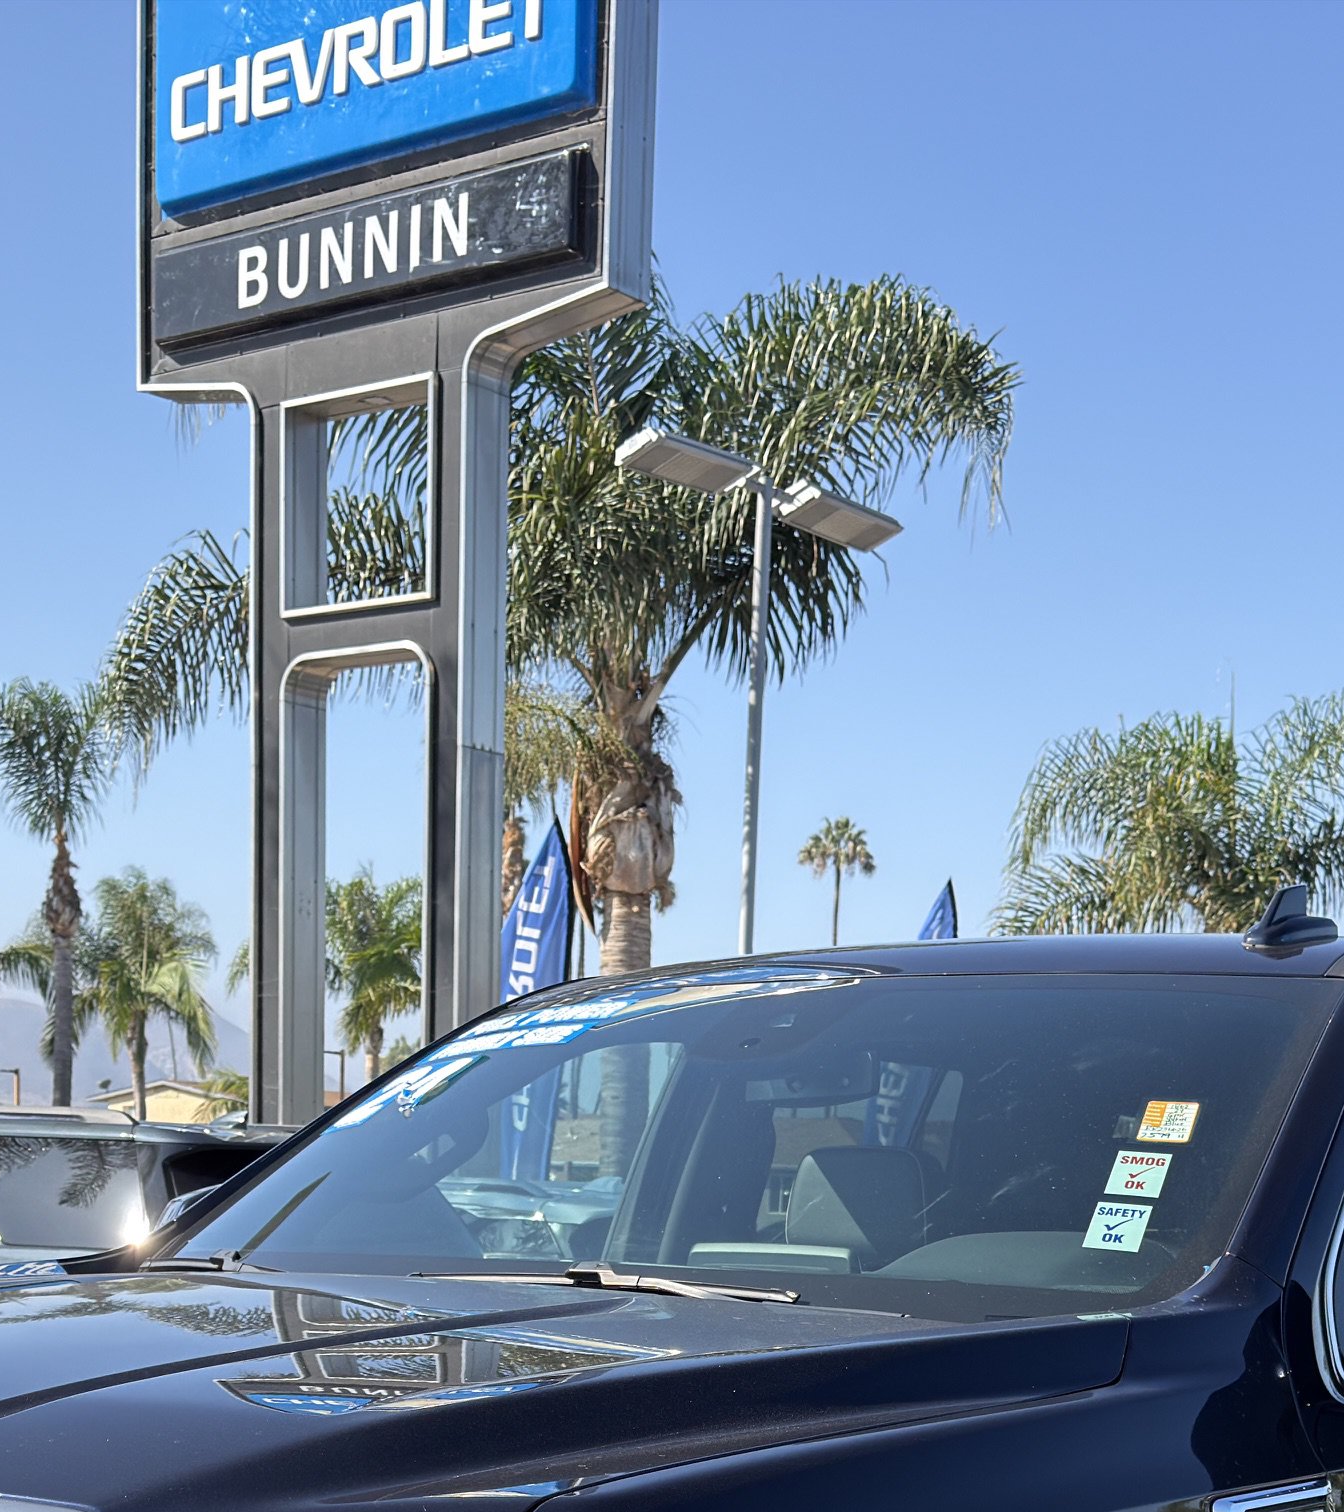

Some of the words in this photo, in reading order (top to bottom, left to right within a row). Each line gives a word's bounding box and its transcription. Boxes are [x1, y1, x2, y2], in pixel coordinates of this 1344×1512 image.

[171, 0, 545, 143] CHEVROLET
[237, 192, 470, 310] BUNNIN
[1120, 1155, 1167, 1168] SMOG
[1124, 1180, 1146, 1191] OK
[1097, 1206, 1147, 1220] SAFETY
[1102, 1233, 1124, 1244] OK
